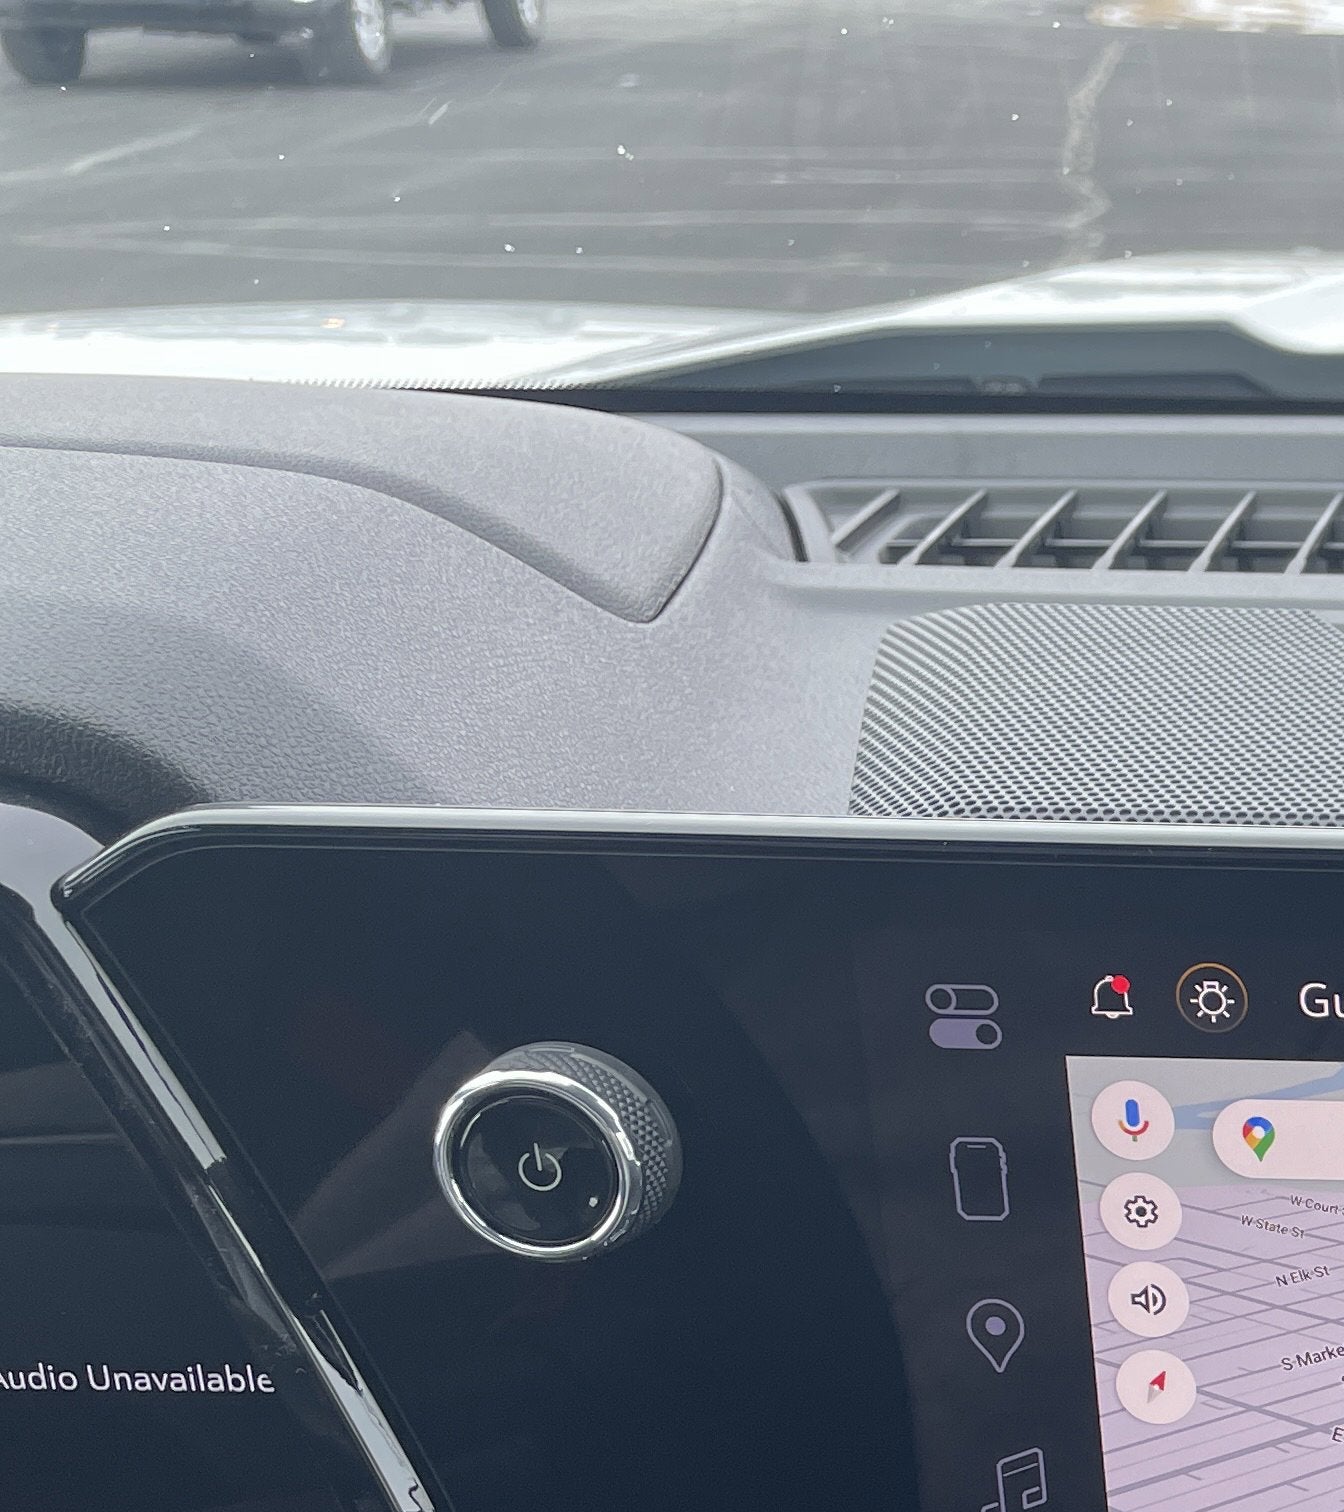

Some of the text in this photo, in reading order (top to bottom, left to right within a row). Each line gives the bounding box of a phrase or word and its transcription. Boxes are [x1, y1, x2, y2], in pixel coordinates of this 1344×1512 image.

[1275, 1265, 1330, 1287] N Elk St
[1281, 1358, 1294, 1371] S
[86, 1364, 276, 1394] Unavailable
[1332, 1427, 1344, 1442] E
